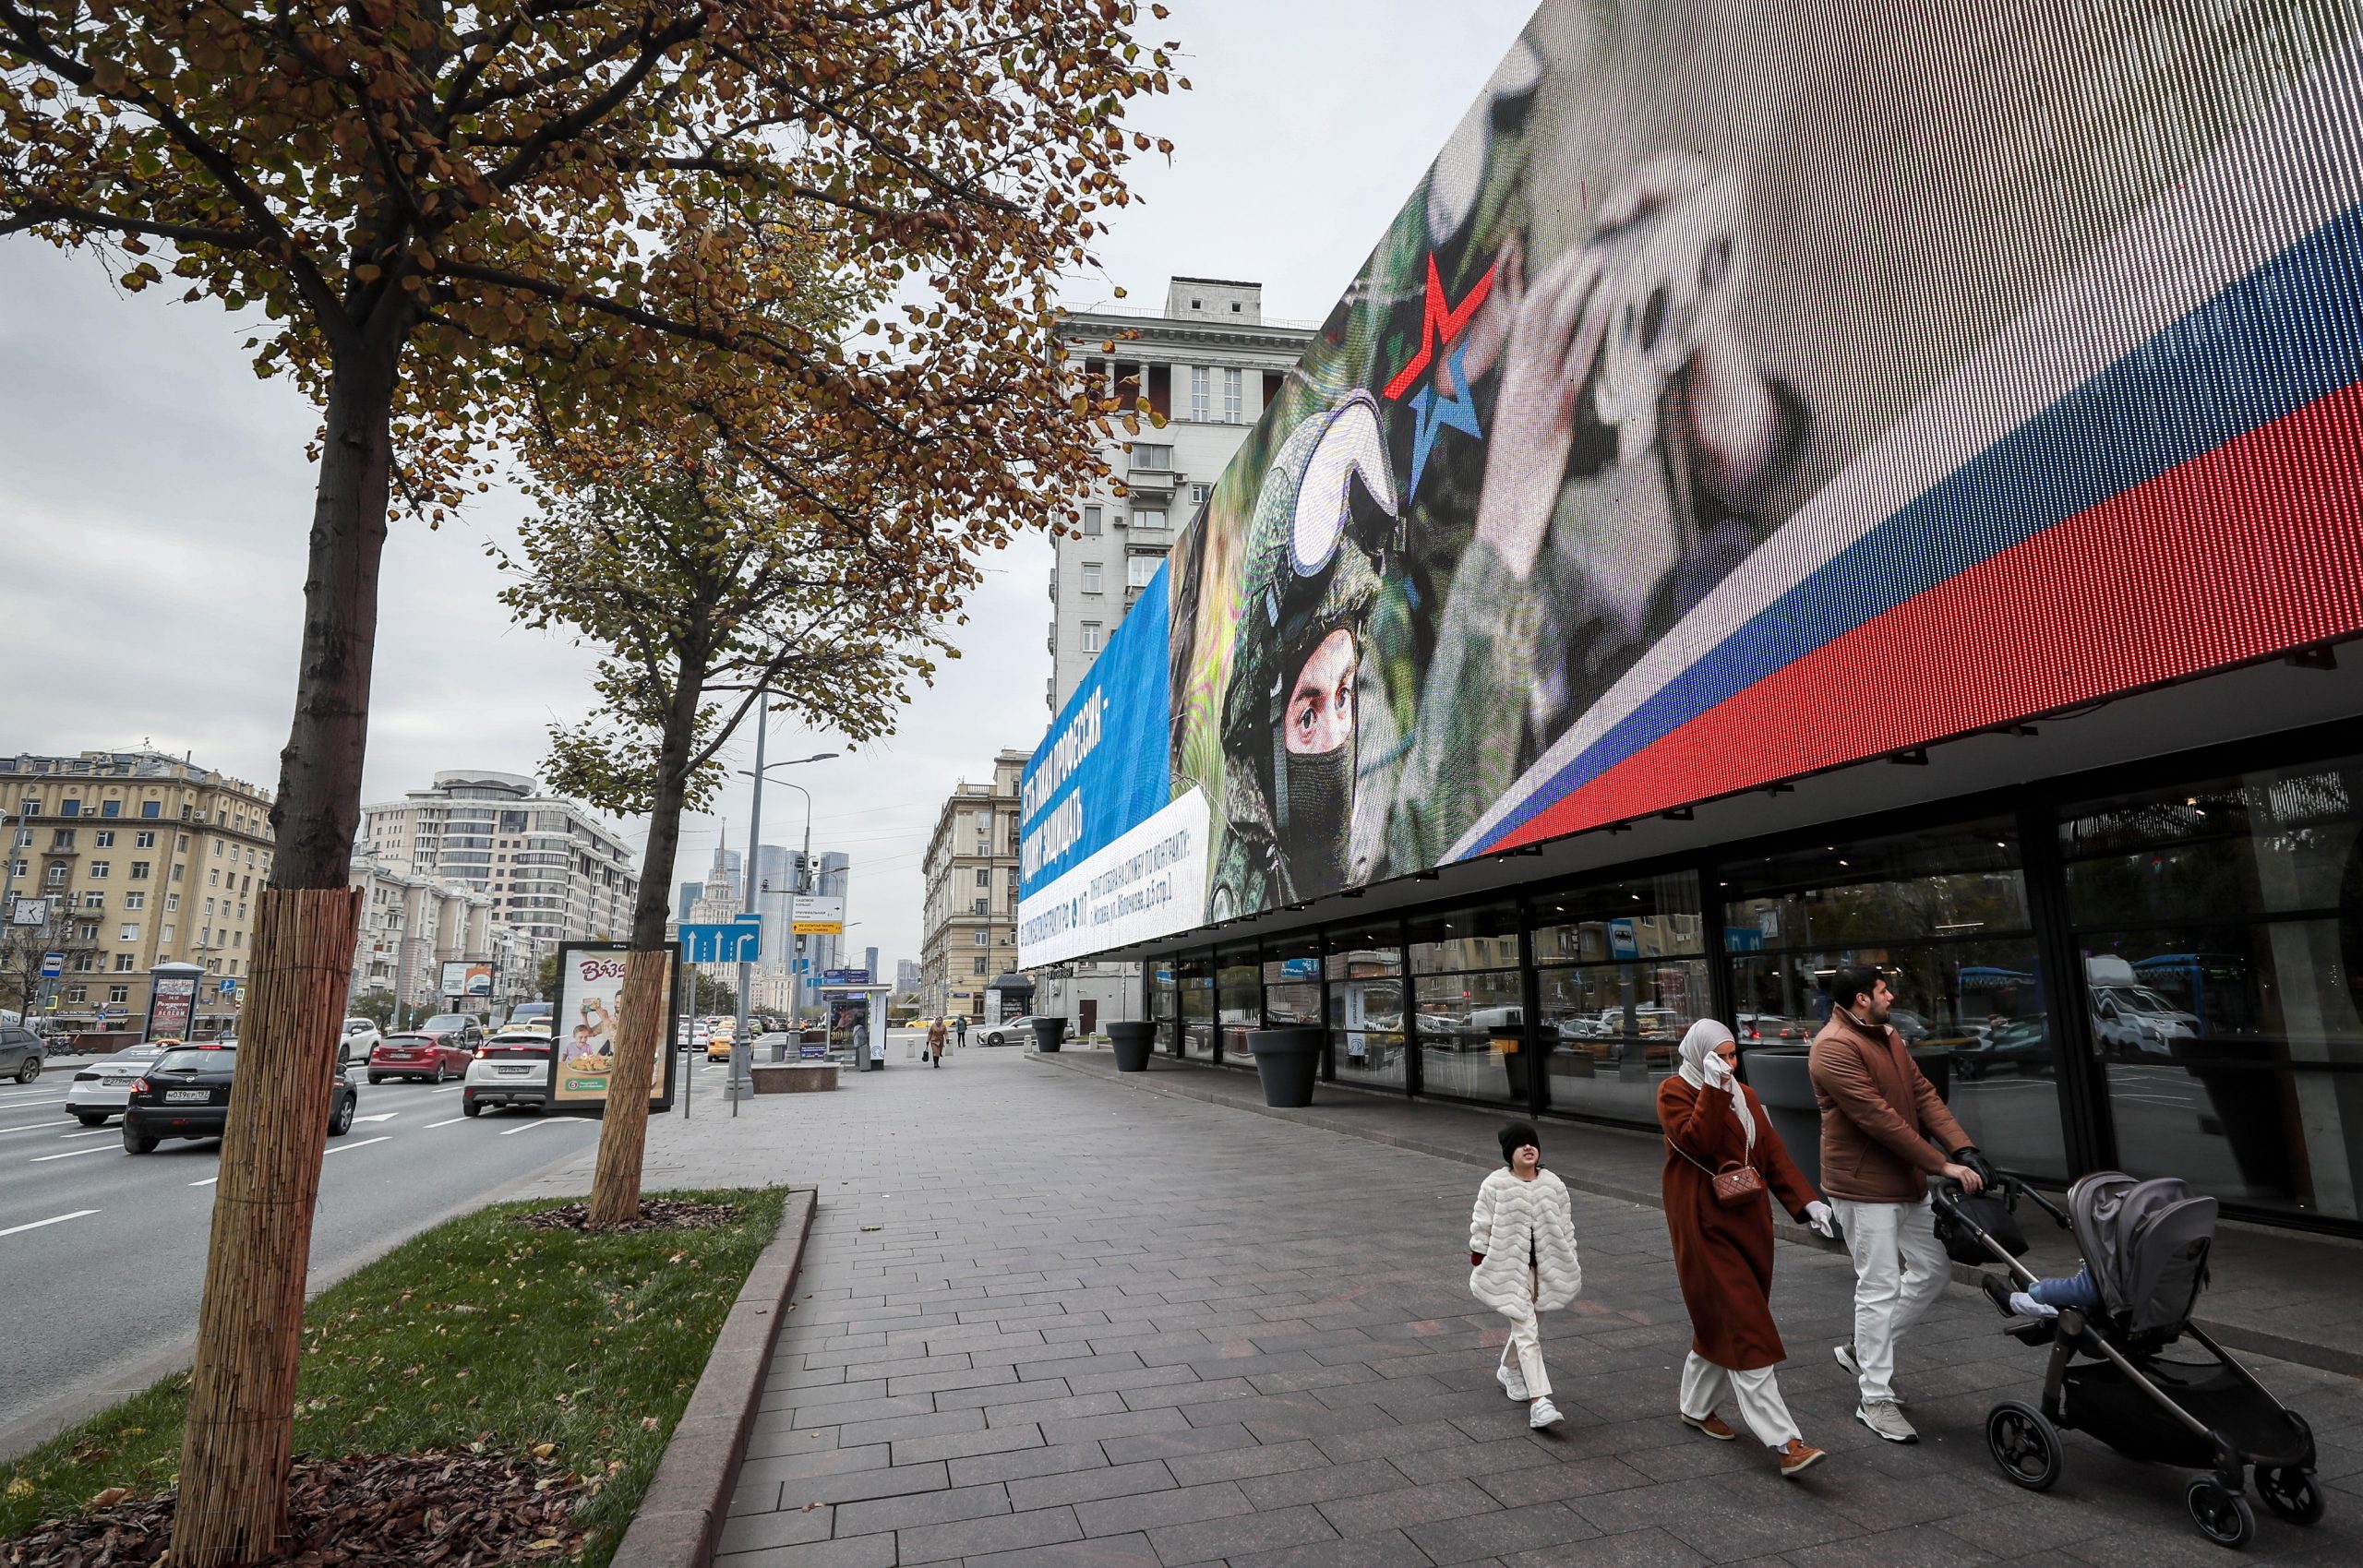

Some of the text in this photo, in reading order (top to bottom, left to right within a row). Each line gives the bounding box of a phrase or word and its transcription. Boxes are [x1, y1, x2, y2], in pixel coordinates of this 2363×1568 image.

[1023, 777, 1035, 827] ЕСТЬ
[1035, 750, 1052, 813] ТАКАЯ
[1053, 685, 1100, 793] ПРОФЕССИЯ
[1022, 790, 1082, 885] РОДИНУ ЗАЩИЩАТЬ
[1125, 853, 1144, 886] СЛУЖБУ
[1145, 848, 1153, 877] ПО
